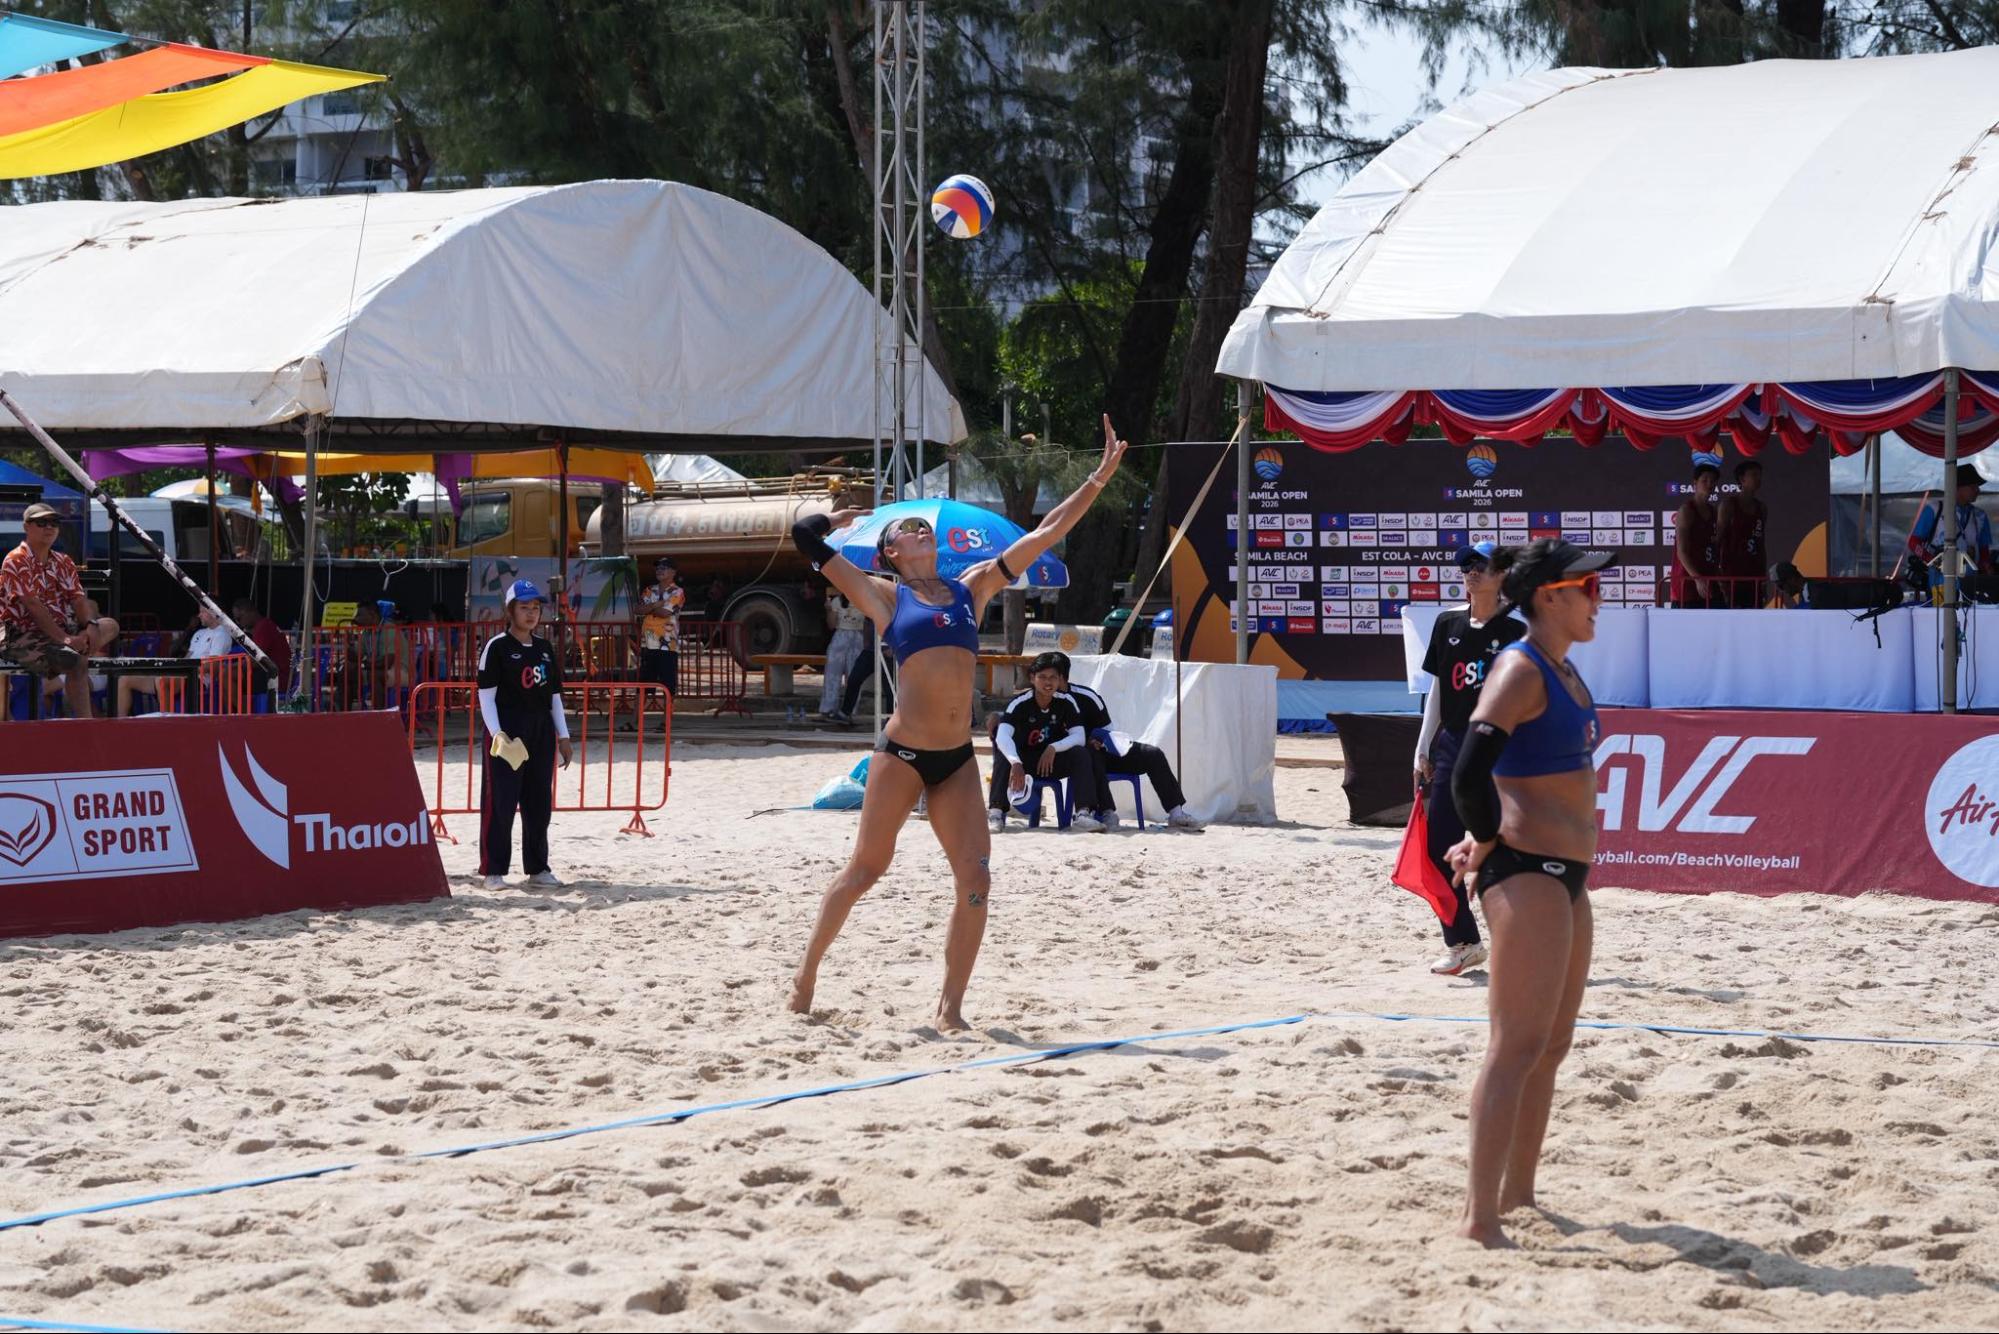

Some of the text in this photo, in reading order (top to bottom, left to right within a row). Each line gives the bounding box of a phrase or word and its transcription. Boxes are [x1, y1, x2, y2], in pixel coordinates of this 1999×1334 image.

[1281, 491, 1308, 500] OPEN
[1456, 489, 1493, 498] SAMILA
[1495, 489, 1522, 498] OPEN
[1259, 516, 1280, 525] AVC
[1442, 514, 1464, 524] AVC
[947, 527, 991, 553] est
[1234, 551, 1308, 560] SMILA BEACH
[1361, 551, 1380, 561] EST
[1382, 551, 1412, 561] COLA
[1421, 551, 1443, 561] AVC
[1260, 568, 1281, 577] AVC
[1355, 620, 1377, 630] AVC
[521, 664, 547, 689] est
[1451, 659, 1485, 691] est
[1592, 733, 1818, 834] AVC
[73, 790, 166, 821] GRAND
[294, 808, 429, 853] Thaioil
[83, 825, 171, 857] SPORT
